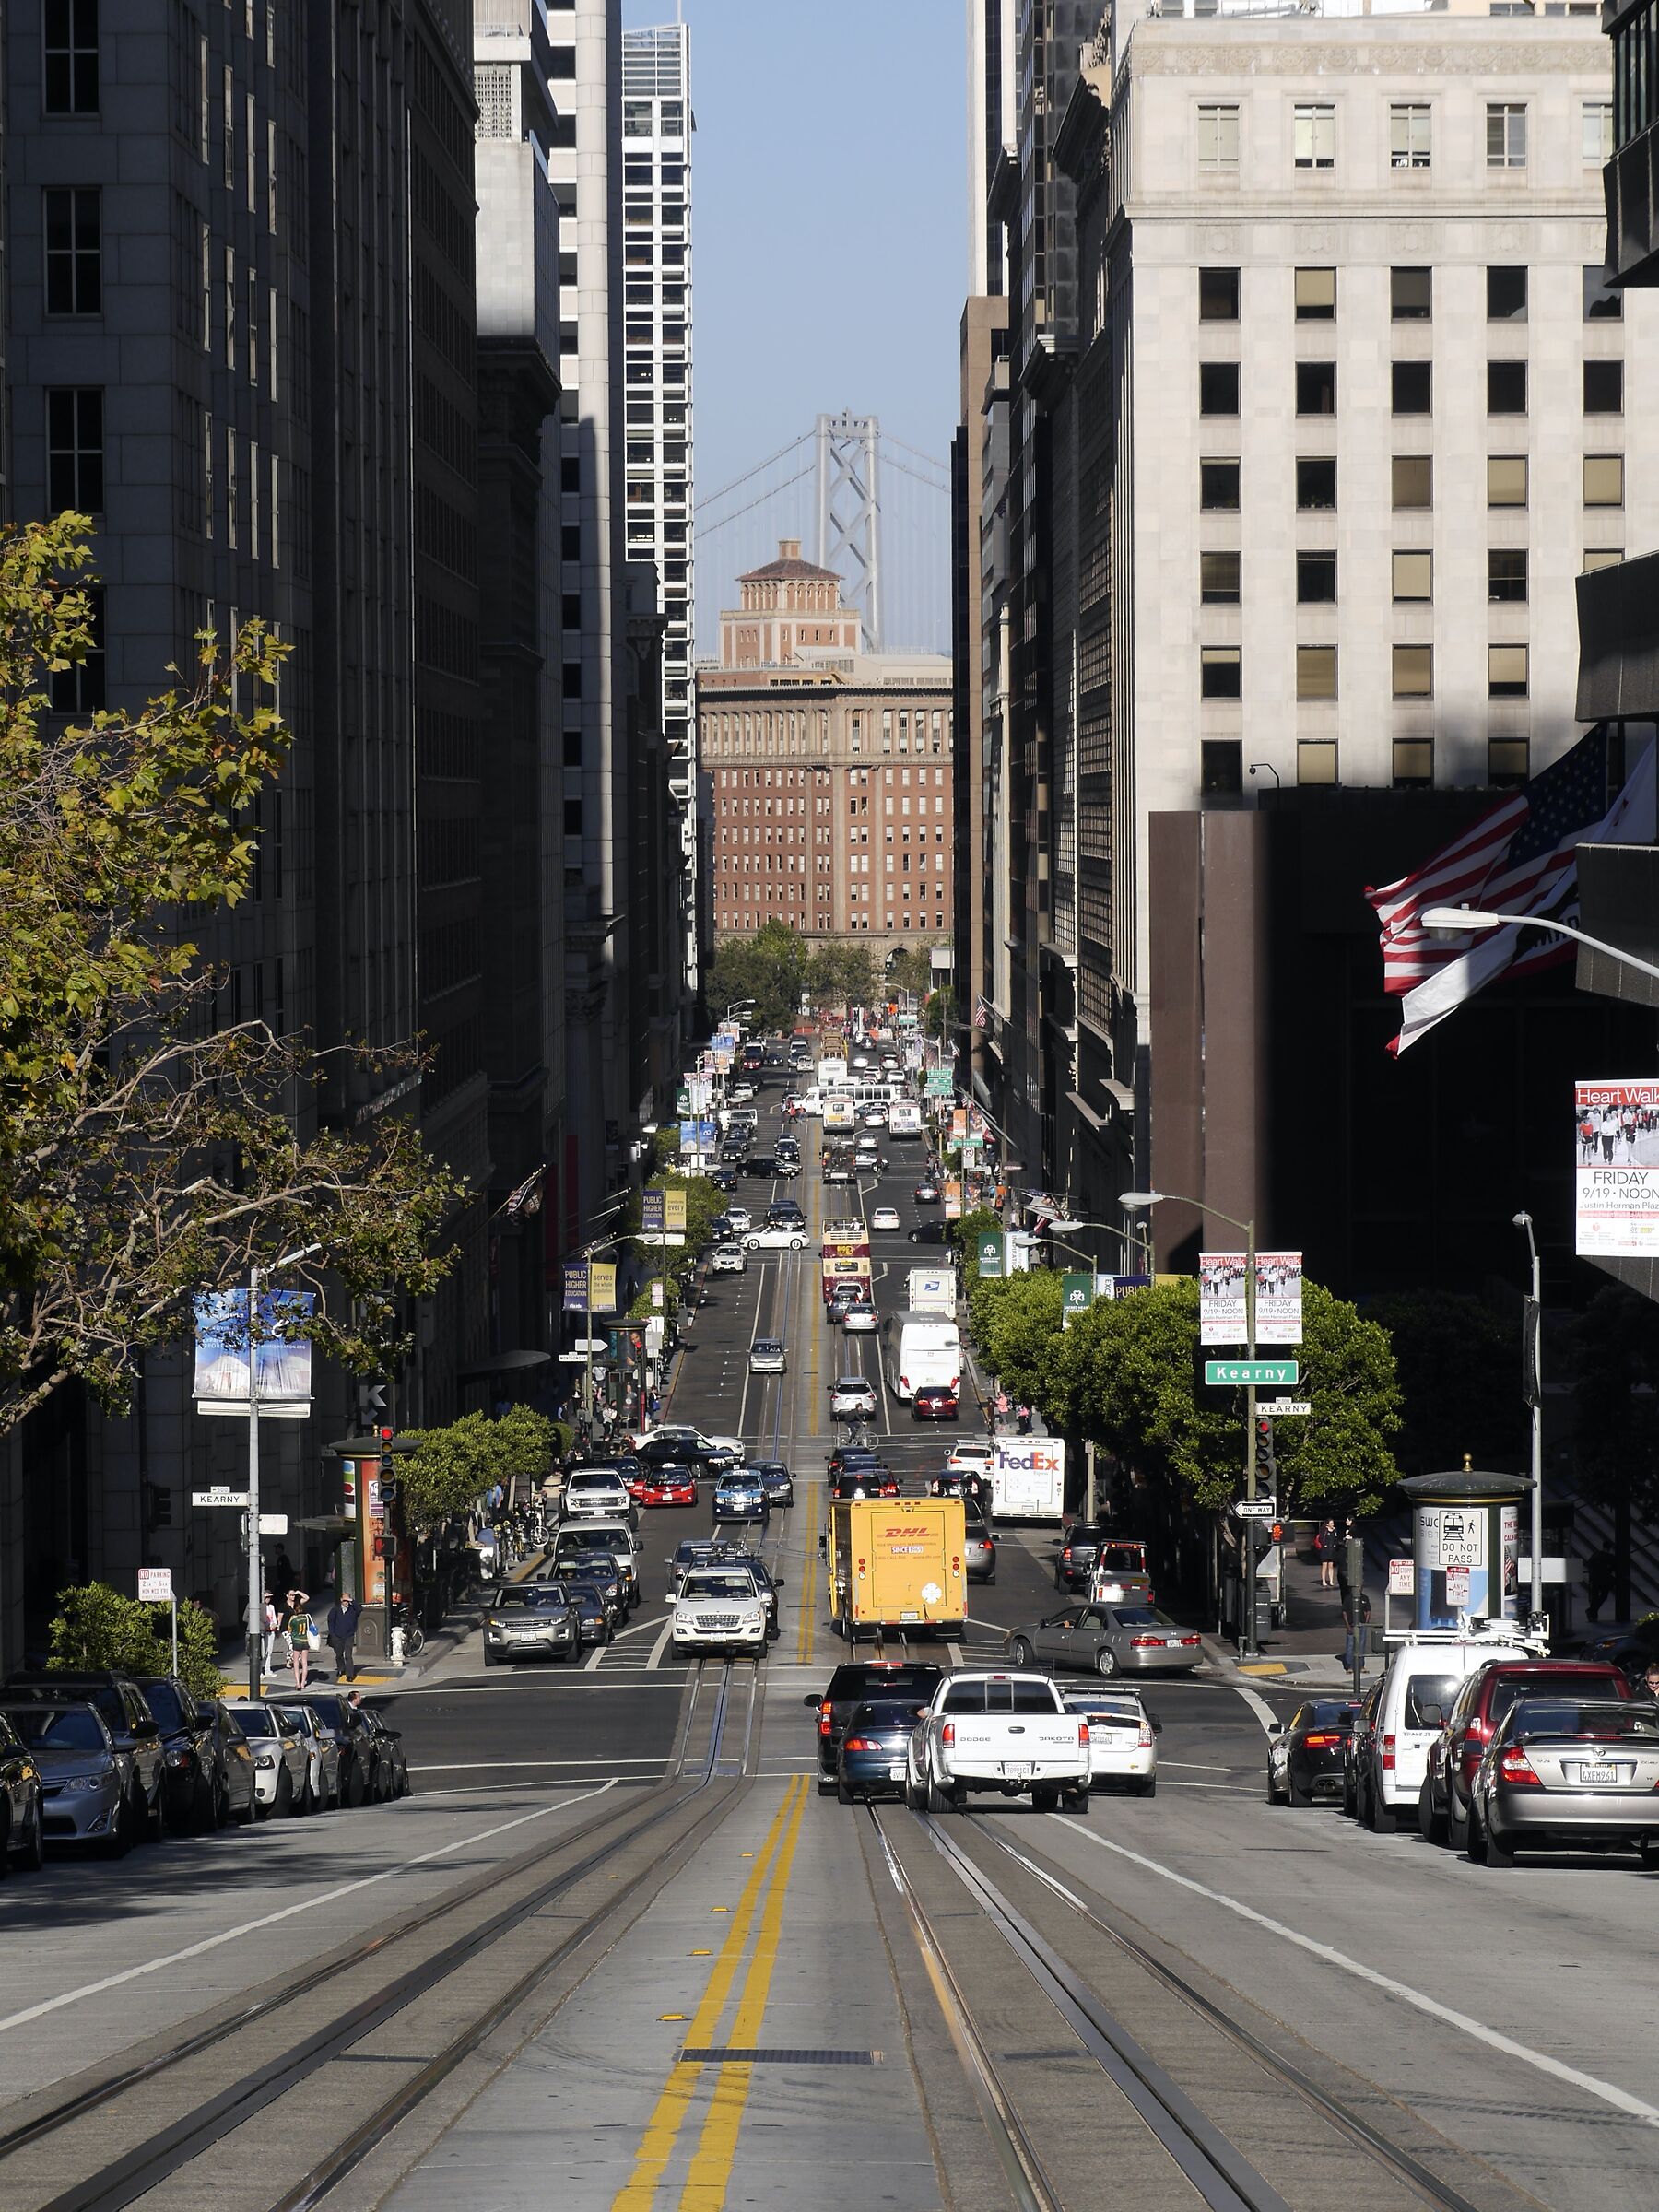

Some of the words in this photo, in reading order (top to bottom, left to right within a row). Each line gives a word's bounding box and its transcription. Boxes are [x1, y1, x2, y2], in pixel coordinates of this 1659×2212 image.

[1578, 1088, 1621, 1103] Heart
[1625, 1088, 1659, 1103] Walk
[1594, 1171, 1648, 1185] FRIDAY
[1583, 1188, 1610, 1199] 9/19
[1619, 1188, 1659, 1199] NOON
[1580, 1201, 1604, 1209] Justin
[1606, 1201, 1640, 1209] Herman
[1642, 1201, 1659, 1209] Plaz
[1225, 1257, 1245, 1265] Walk
[1256, 1257, 1278, 1265] Heart
[1279, 1257, 1300, 1265] Walk
[564, 1271, 587, 1279] PUBLIC
[565, 1280, 587, 1289] HIGHER
[1217, 1367, 1286, 1381] Kearny
[1261, 1405, 1307, 1413] KEARNY
[999, 1451, 1060, 1471] FedEx
[200, 1495, 240, 1503] KEARNY
[1504, 1521, 1512, 1529] THE
[885, 1527, 930, 1538] DHL
[1442, 1543, 1455, 1552] DO
[1460, 1544, 1478, 1552] NOT
[1448, 1555, 1473, 1563] PASS
[141, 1570, 148, 1579] NO
[1391, 1566, 1399, 1574] NO
[1582, 1771, 1614, 1781] 4XFM961
